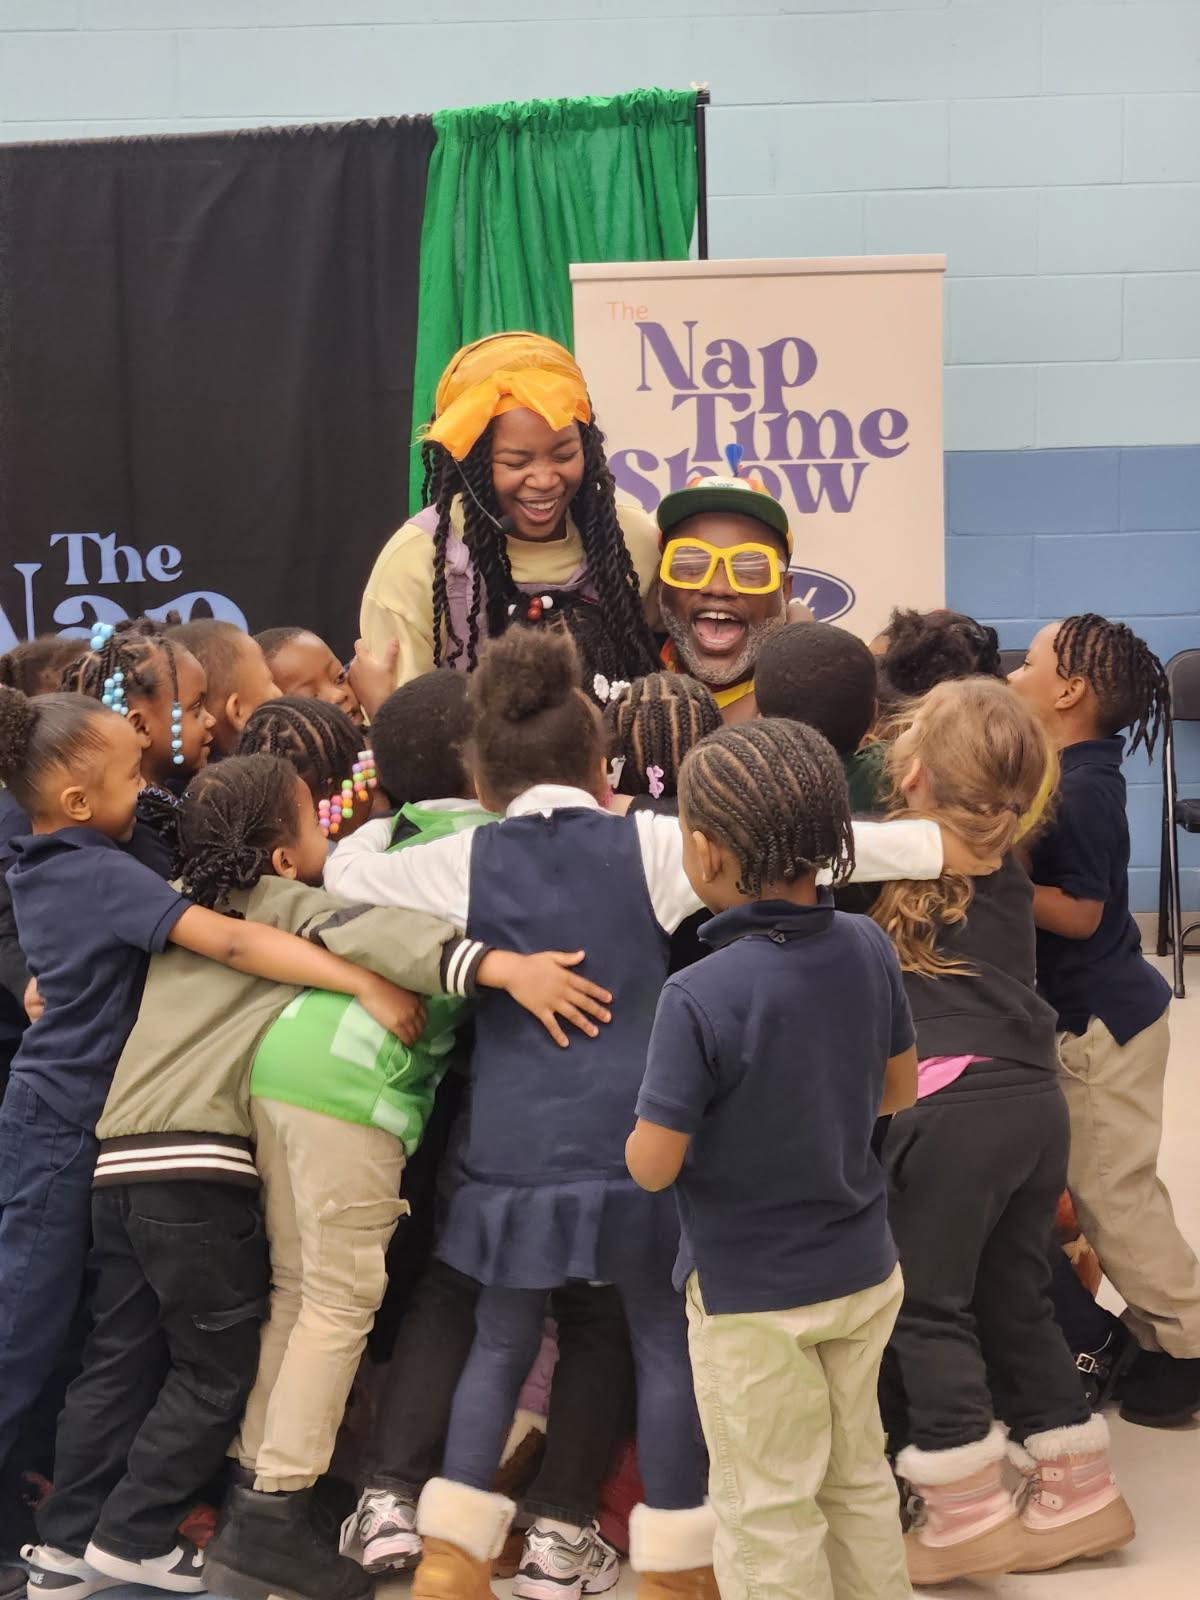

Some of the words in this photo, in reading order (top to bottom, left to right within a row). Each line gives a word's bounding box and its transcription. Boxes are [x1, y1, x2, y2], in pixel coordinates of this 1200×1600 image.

[605, 301, 648, 320] The
[635, 321, 818, 414] Nap
[672, 393, 909, 462] Time
[50, 532, 183, 585] The
